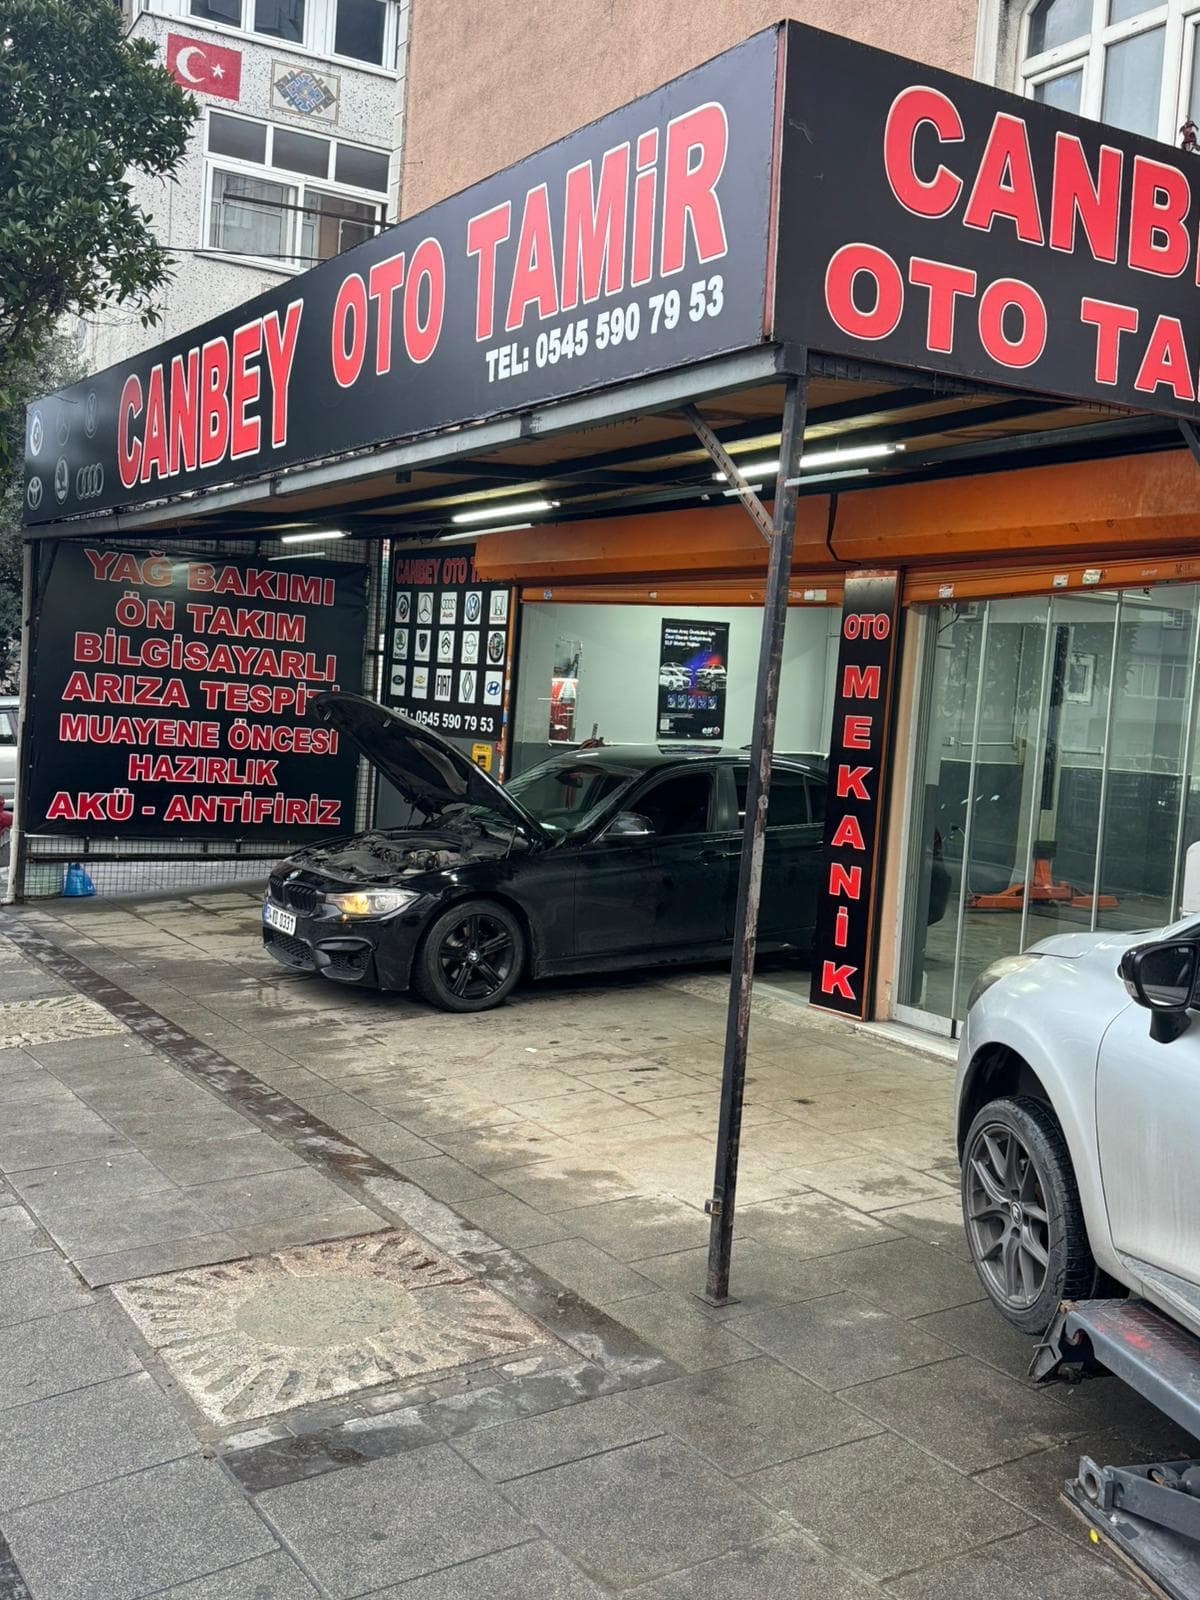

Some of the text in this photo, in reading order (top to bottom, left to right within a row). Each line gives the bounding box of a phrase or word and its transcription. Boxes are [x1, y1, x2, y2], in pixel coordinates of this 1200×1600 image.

[884, 85, 1200, 286] CANB
[486, 275, 724, 382] TEL: 0545 590 79 53
[825, 242, 1200, 401] OTO TA
[118, 298, 303, 488] CANBEY
[332, 237, 445, 387] OTO
[84, 547, 335, 606] YAĞ BAKIMI
[443, 557, 467, 584] OTO
[116, 592, 305, 642] ÖN TAKIM
[844, 613, 889, 640] OTO
[74, 628, 336, 682] BİLGİSAYARLI
[62, 671, 189, 707] ARIZA
[60, 714, 219, 748] MUAYENE
[416, 710, 440, 726] 0545
[442, 713, 461, 728] 590
[464, 716, 477, 730] 79
[480, 717, 494, 732] 53
[128, 755, 278, 785] HAZIRLIK
[46, 788, 341, 825] AKÜ - ANTİFİRİZ
